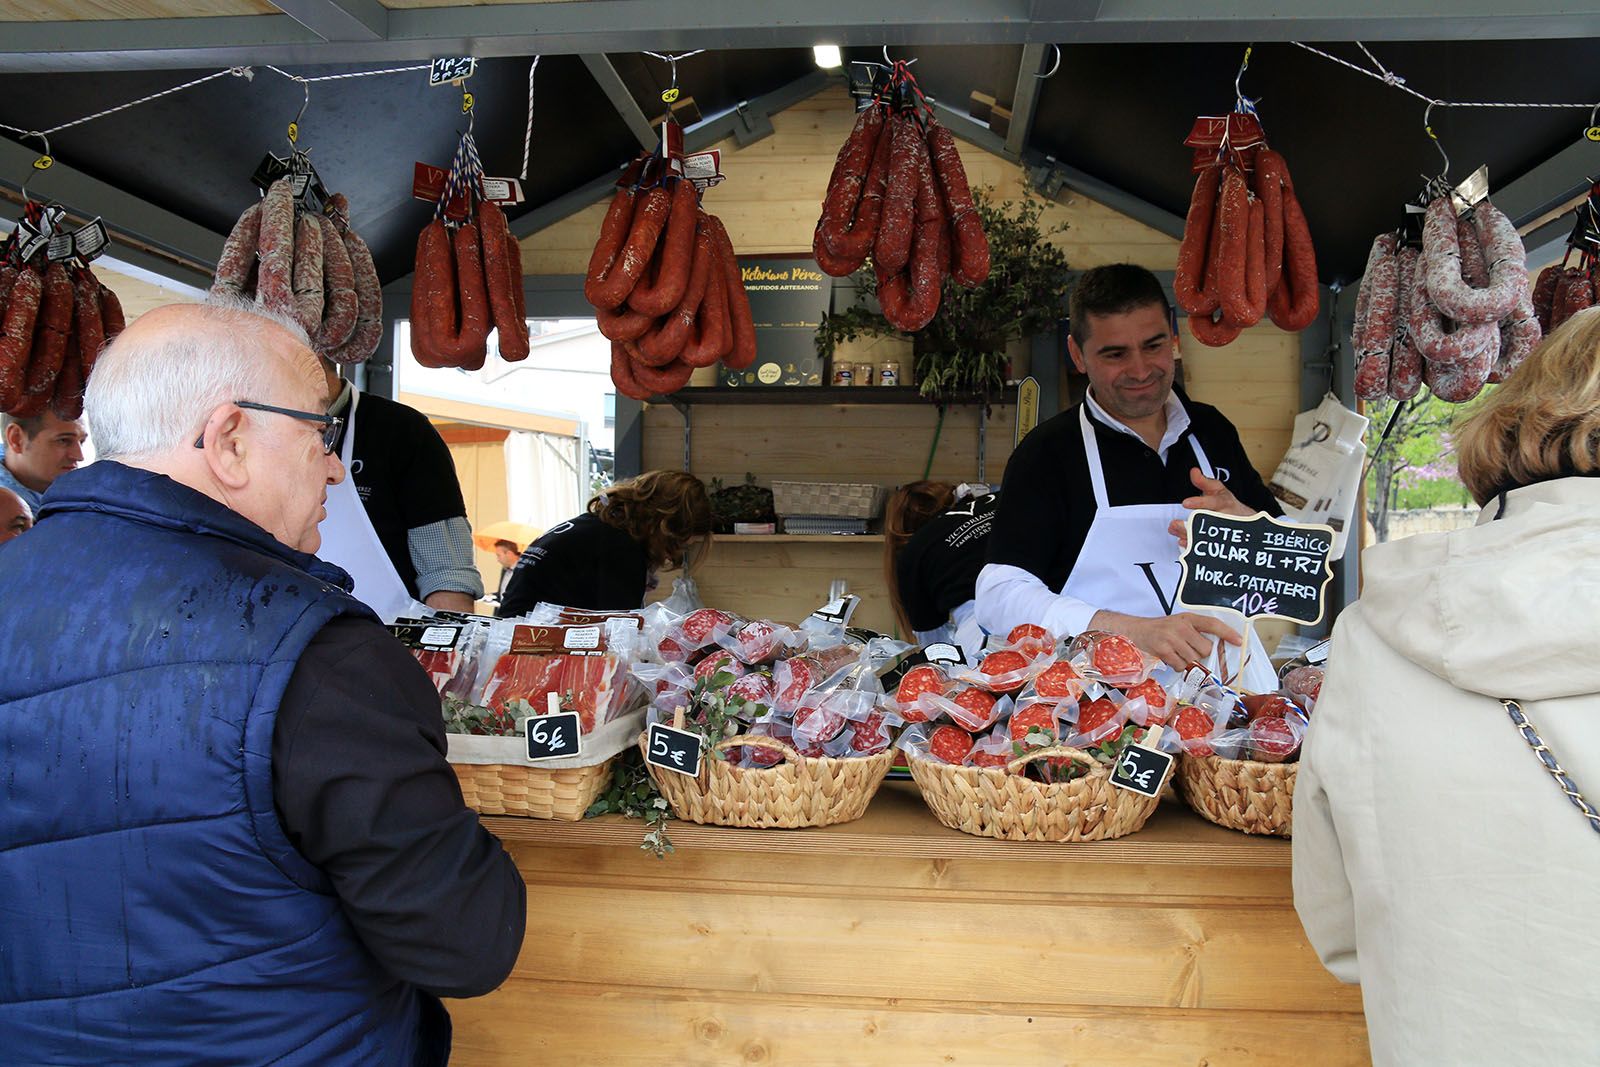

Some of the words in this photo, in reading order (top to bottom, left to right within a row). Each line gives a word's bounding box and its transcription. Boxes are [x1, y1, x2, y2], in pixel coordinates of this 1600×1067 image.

[664, 88, 678, 100] 3€
[1198, 518, 1251, 543] LOTE:
[1262, 530, 1330, 554] IBÉRICO
[1193, 540, 1250, 564] CULAR
[1255, 551, 1277, 569] BL
[1231, 591, 1279, 615] 10€
[529, 628, 549, 643] VP
[532, 719, 567, 752] 6€
[651, 732, 687, 767] 5€
[1117, 750, 1155, 789] 5€
